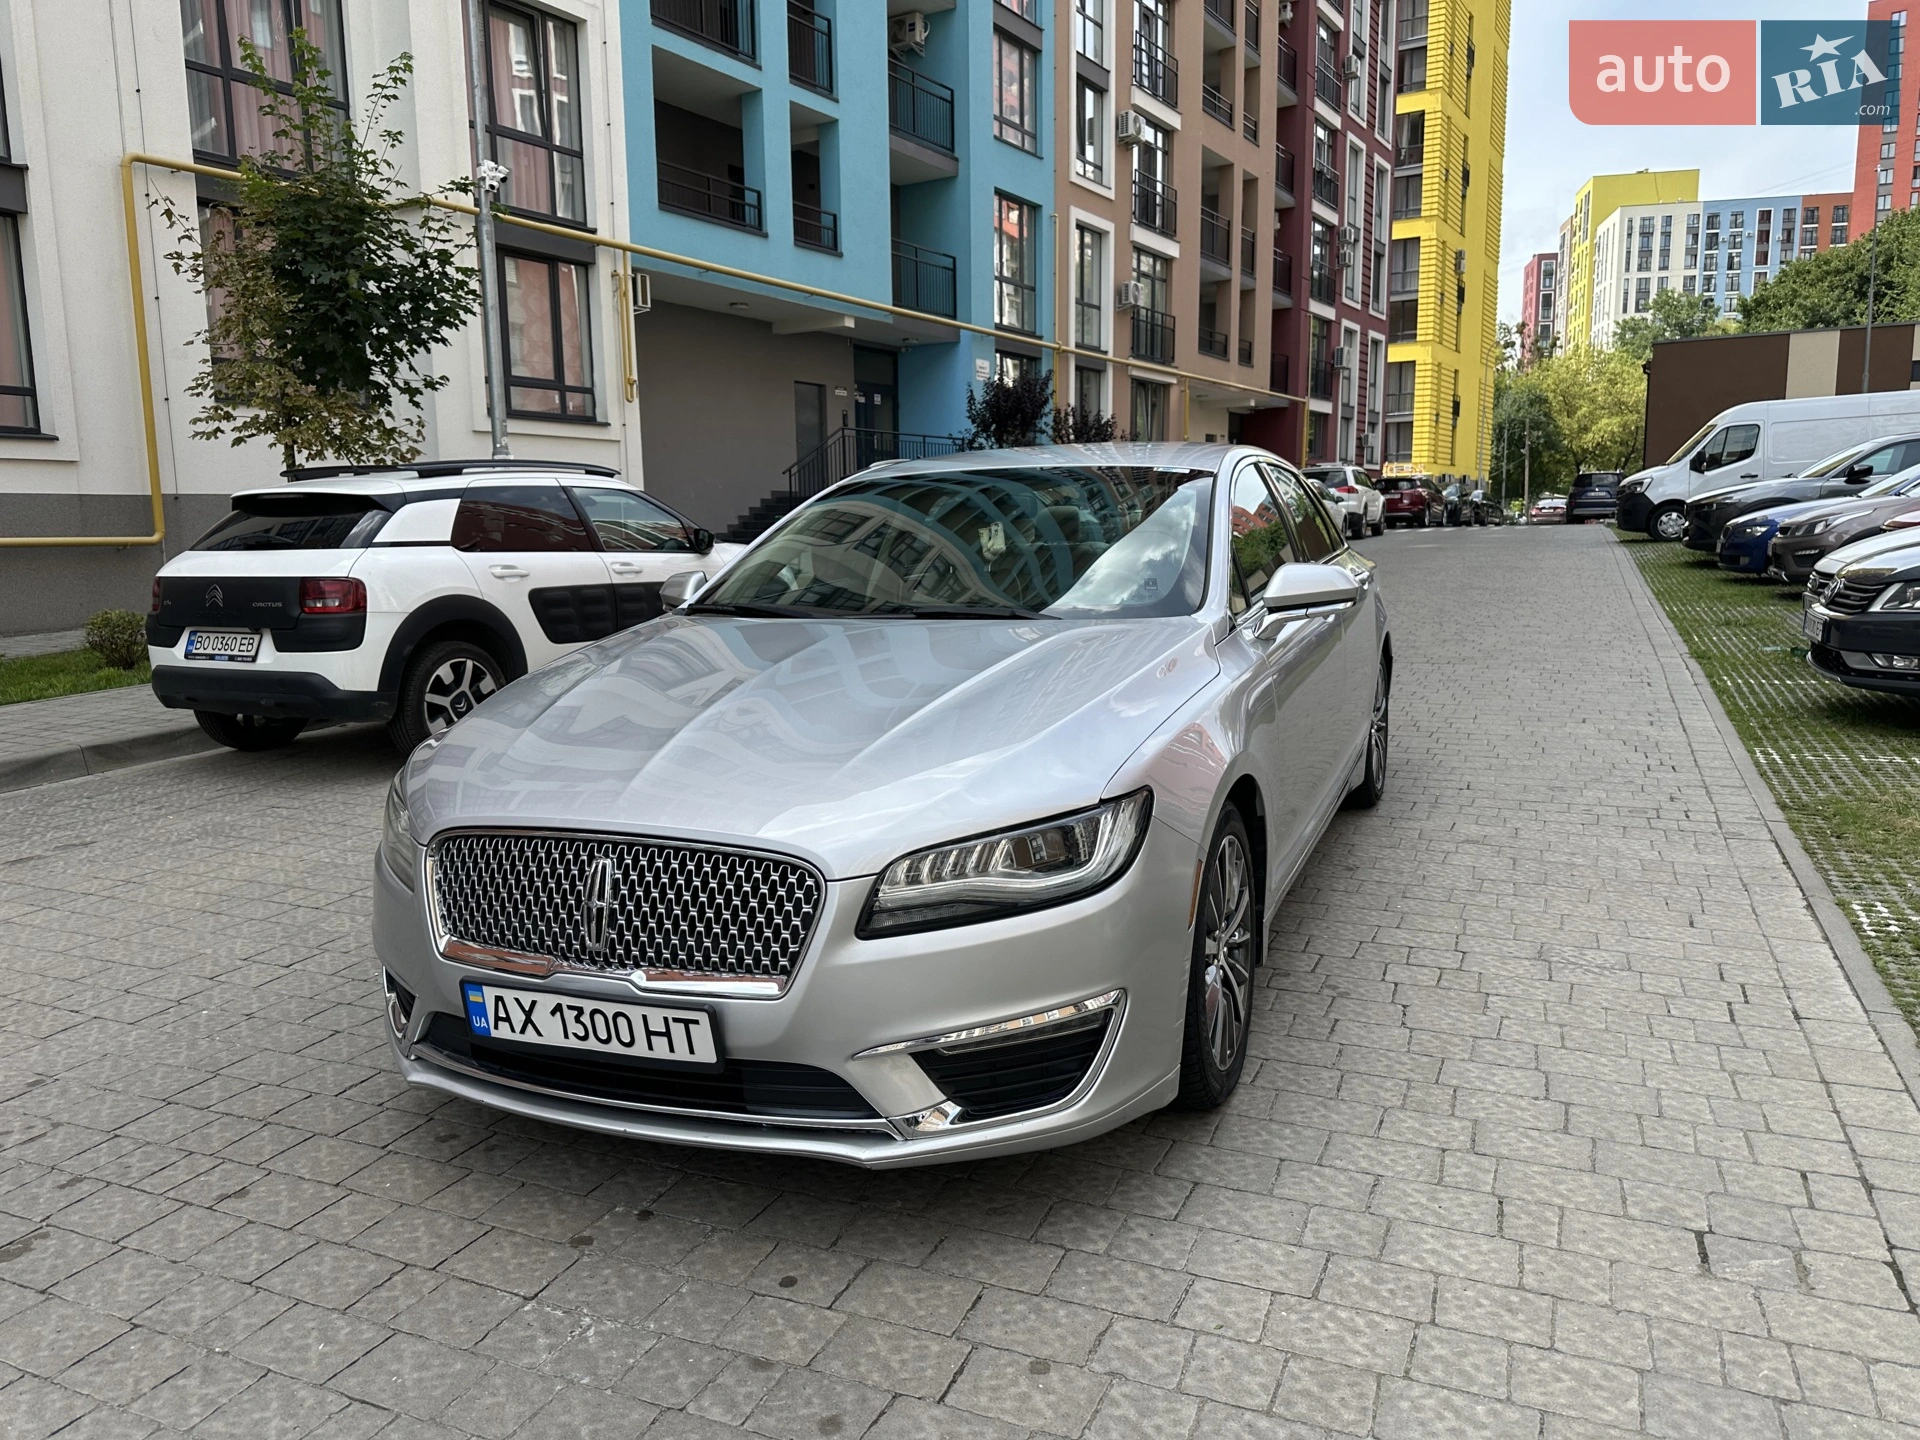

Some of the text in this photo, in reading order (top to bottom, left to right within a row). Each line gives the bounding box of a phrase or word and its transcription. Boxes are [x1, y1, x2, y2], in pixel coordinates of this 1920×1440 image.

[194, 635, 255, 653] BO 0360 EB
[472, 1015, 489, 1030] UA
[493, 995, 700, 1055] AX 1300 HT
